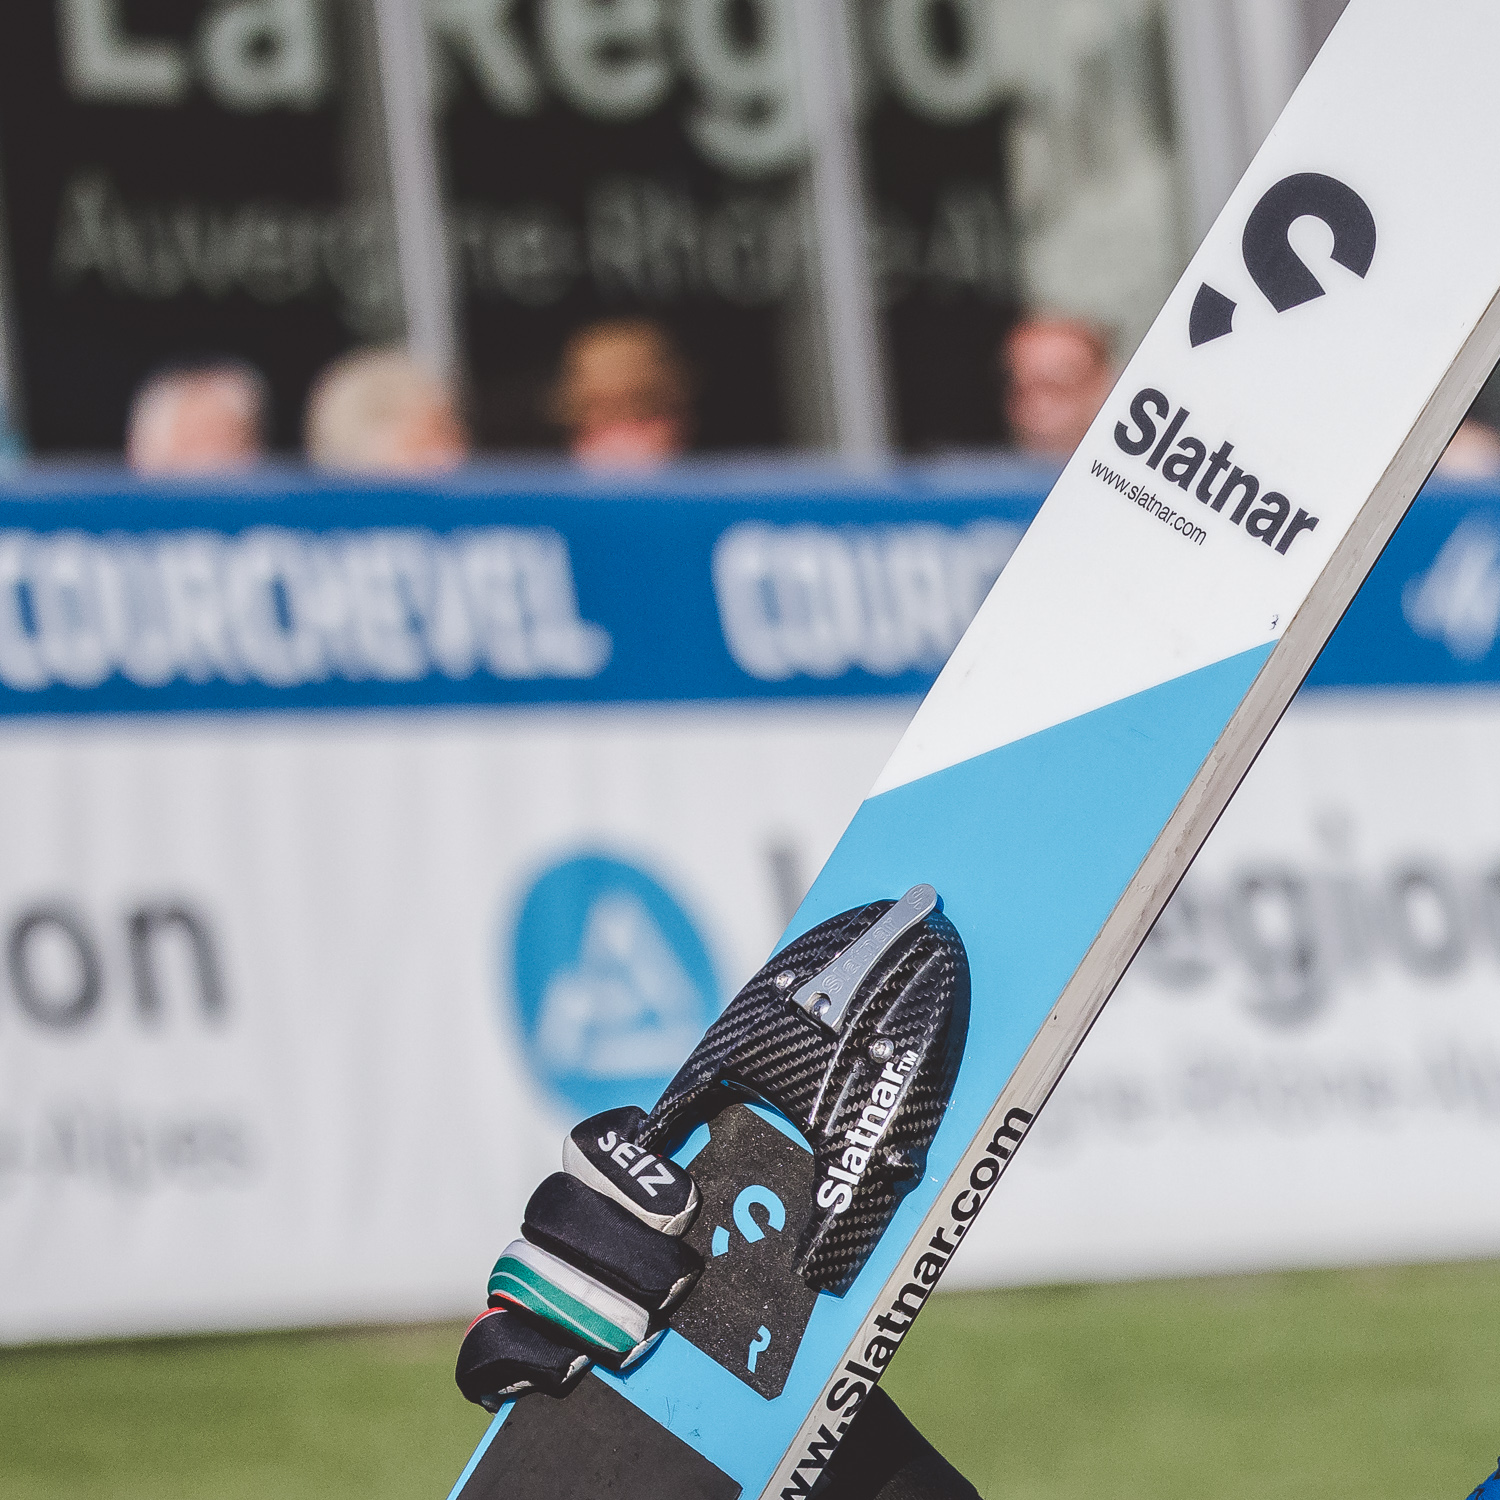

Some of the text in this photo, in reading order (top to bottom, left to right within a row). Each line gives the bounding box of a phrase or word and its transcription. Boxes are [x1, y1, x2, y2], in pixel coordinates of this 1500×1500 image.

[1091, 459, 1208, 546] www.slatnar.com
[1113, 387, 1320, 556] Slatnar
[597, 1130, 676, 1198] SEIZ
